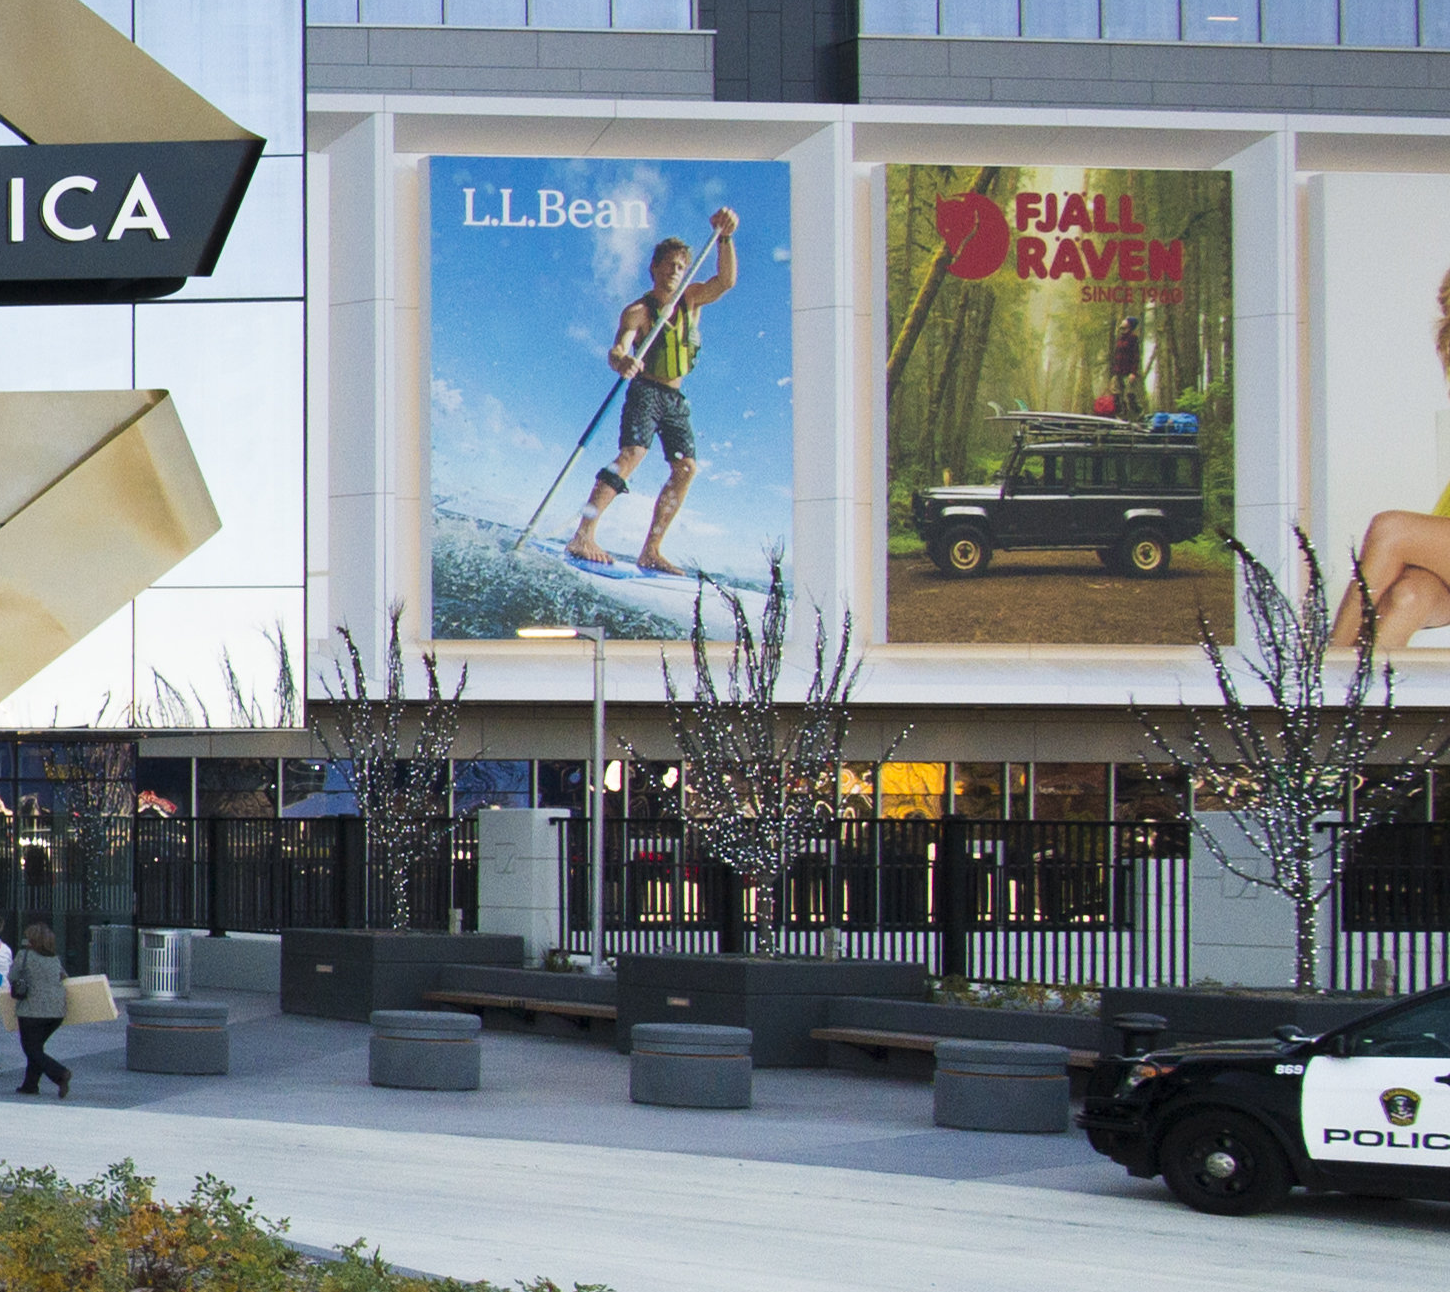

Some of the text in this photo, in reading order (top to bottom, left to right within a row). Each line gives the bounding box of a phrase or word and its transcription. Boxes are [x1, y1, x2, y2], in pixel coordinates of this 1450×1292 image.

[462, 187, 650, 229] L.L.Bean
[1015, 191, 1146, 234] FJÄLL
[1015, 235, 1184, 282] RÄVEN
[1081, 285, 1184, 305] SINCE 1960
[1274, 1063, 1305, 1075] 869
